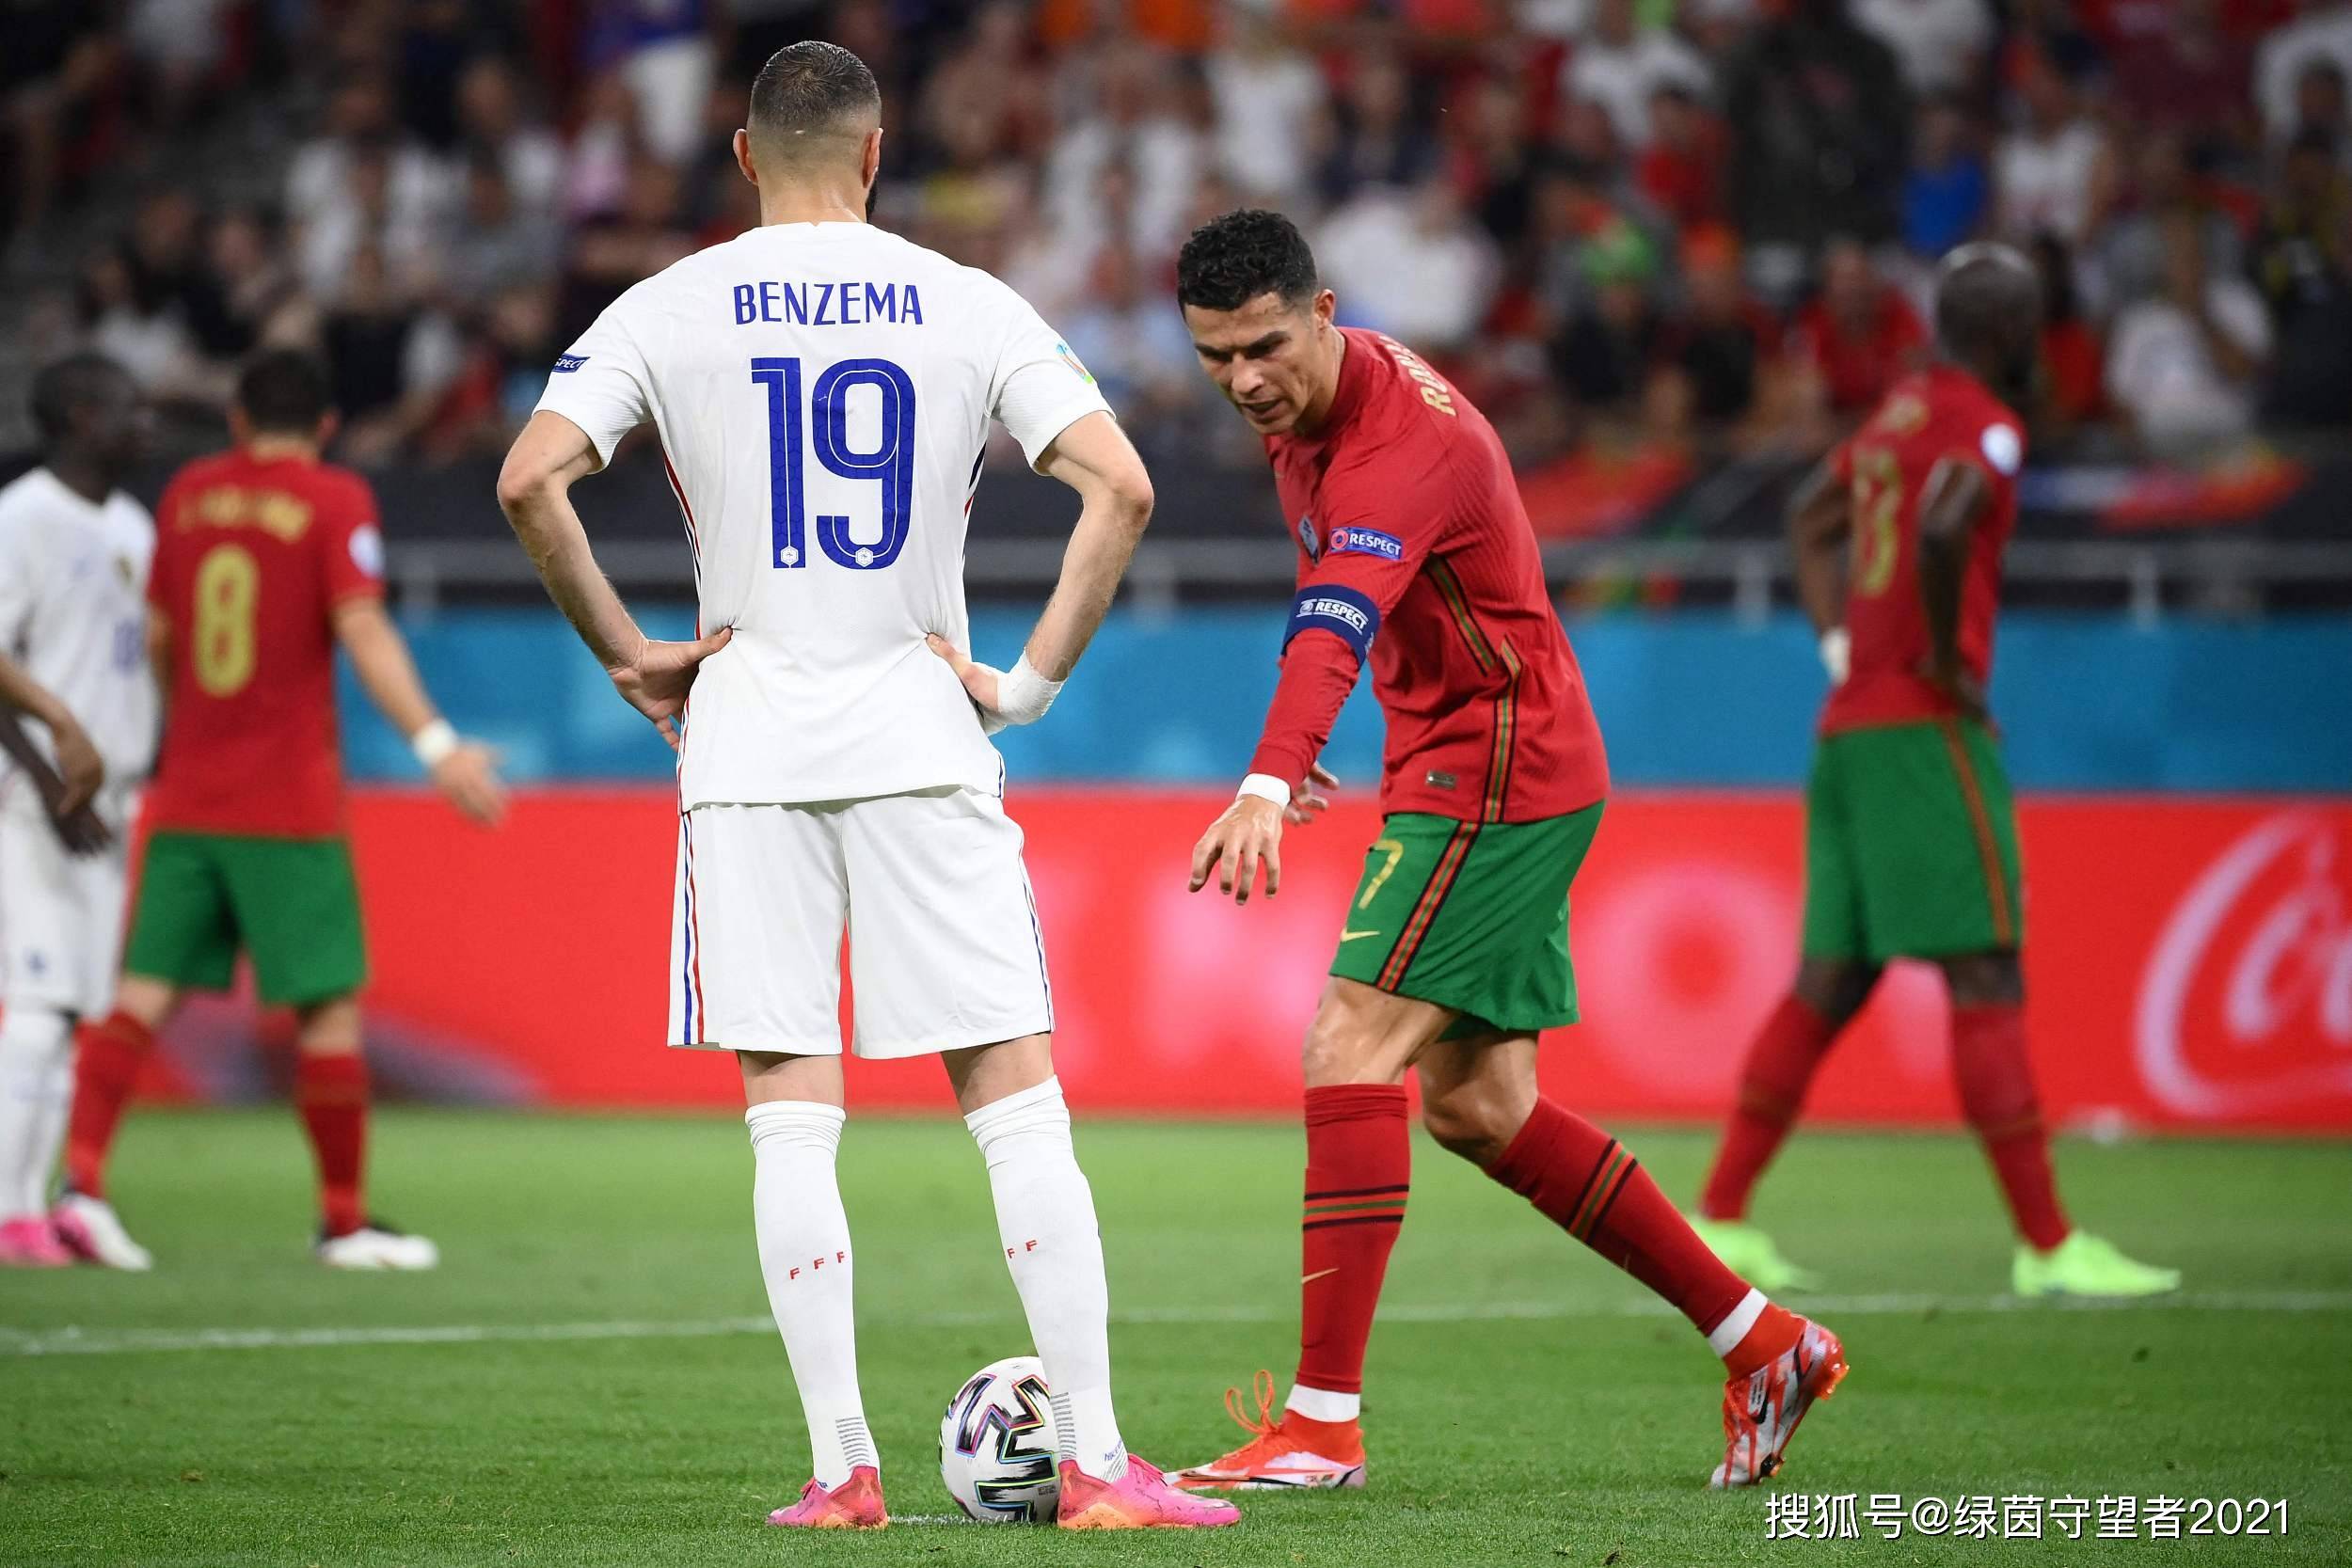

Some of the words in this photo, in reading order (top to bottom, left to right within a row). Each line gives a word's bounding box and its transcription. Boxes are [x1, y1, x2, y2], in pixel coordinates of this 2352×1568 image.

[733, 280, 924, 325] BENZEMA
[750, 356, 917, 570] 19
[1348, 532, 1402, 556] RESPECT
[193, 542, 260, 699] 8
[1314, 600, 1368, 630] RESPECT
[1358, 839, 1404, 911] 7
